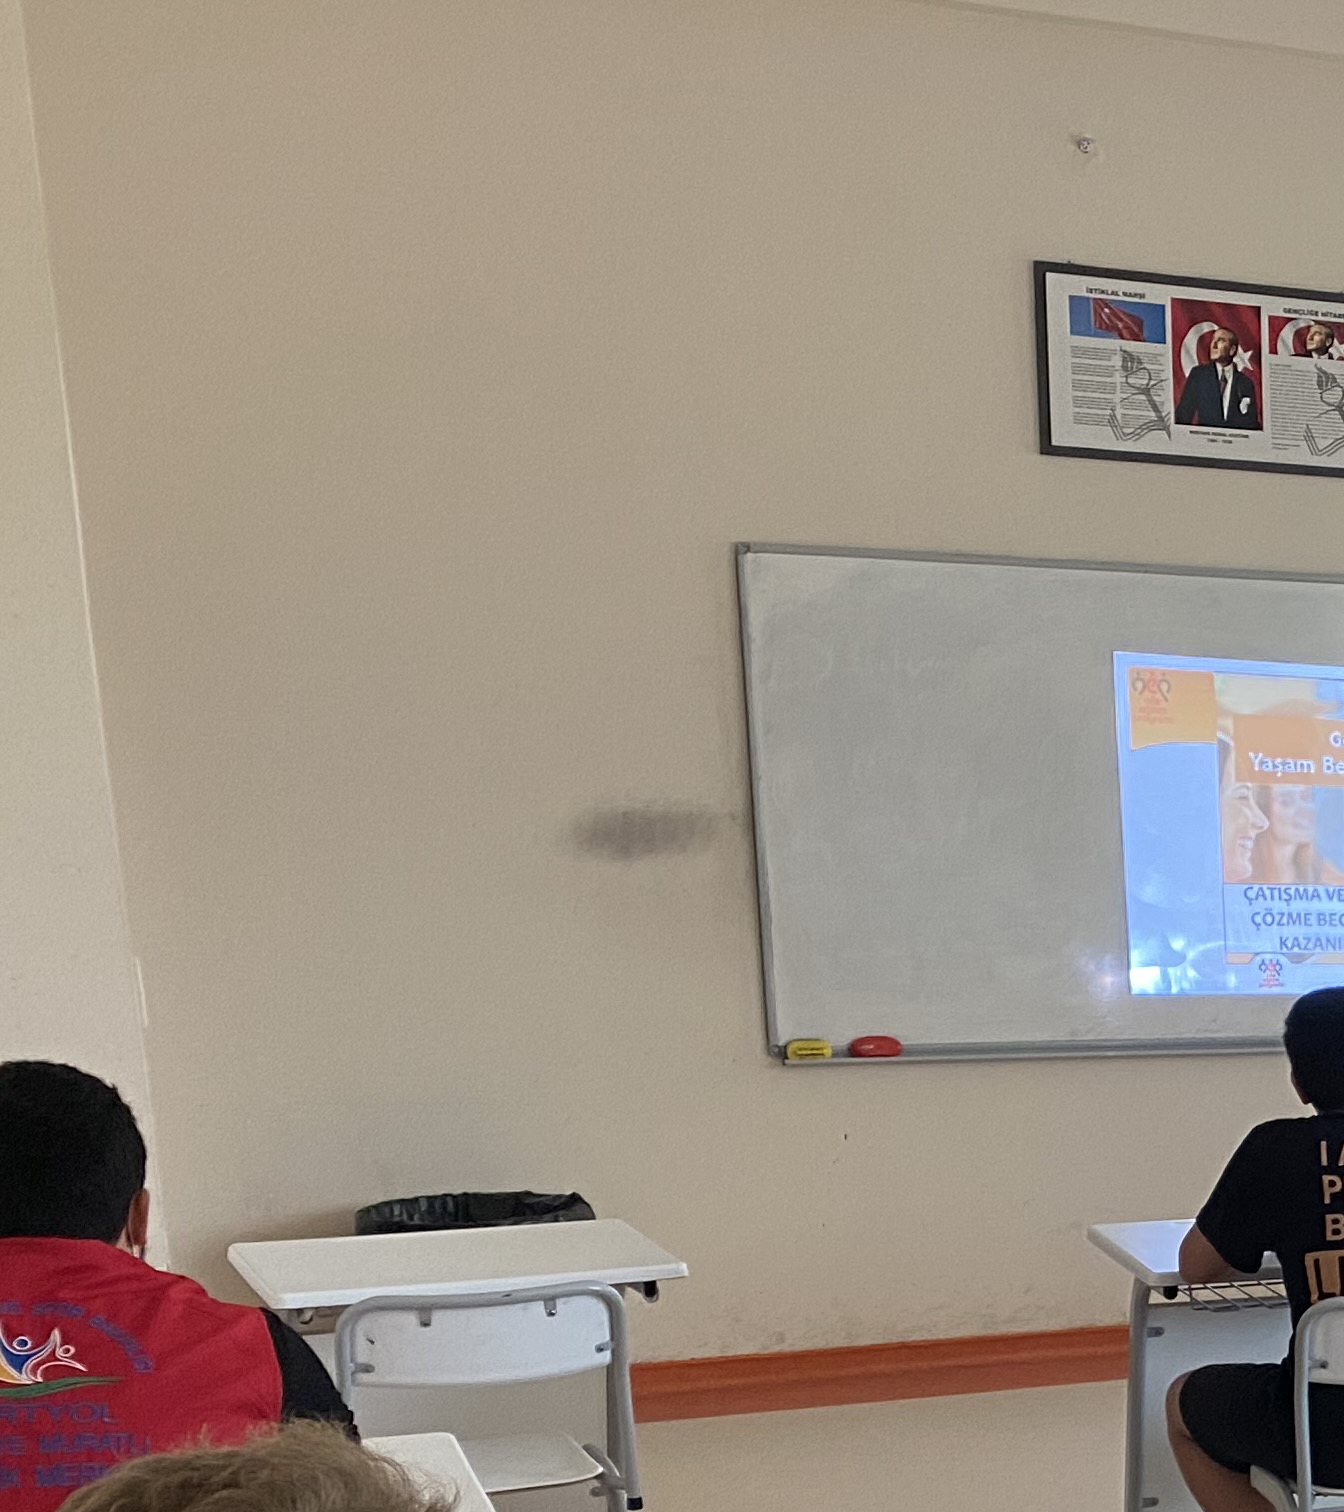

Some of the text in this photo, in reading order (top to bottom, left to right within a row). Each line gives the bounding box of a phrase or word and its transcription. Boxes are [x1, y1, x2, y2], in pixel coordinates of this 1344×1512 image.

[1248, 751, 1316, 777] Yaşam
[1243, 886, 1322, 907] ÇATIŞMA
[1250, 907, 1313, 931] ÇÖZME
[1319, 1140, 1328, 1167] I
